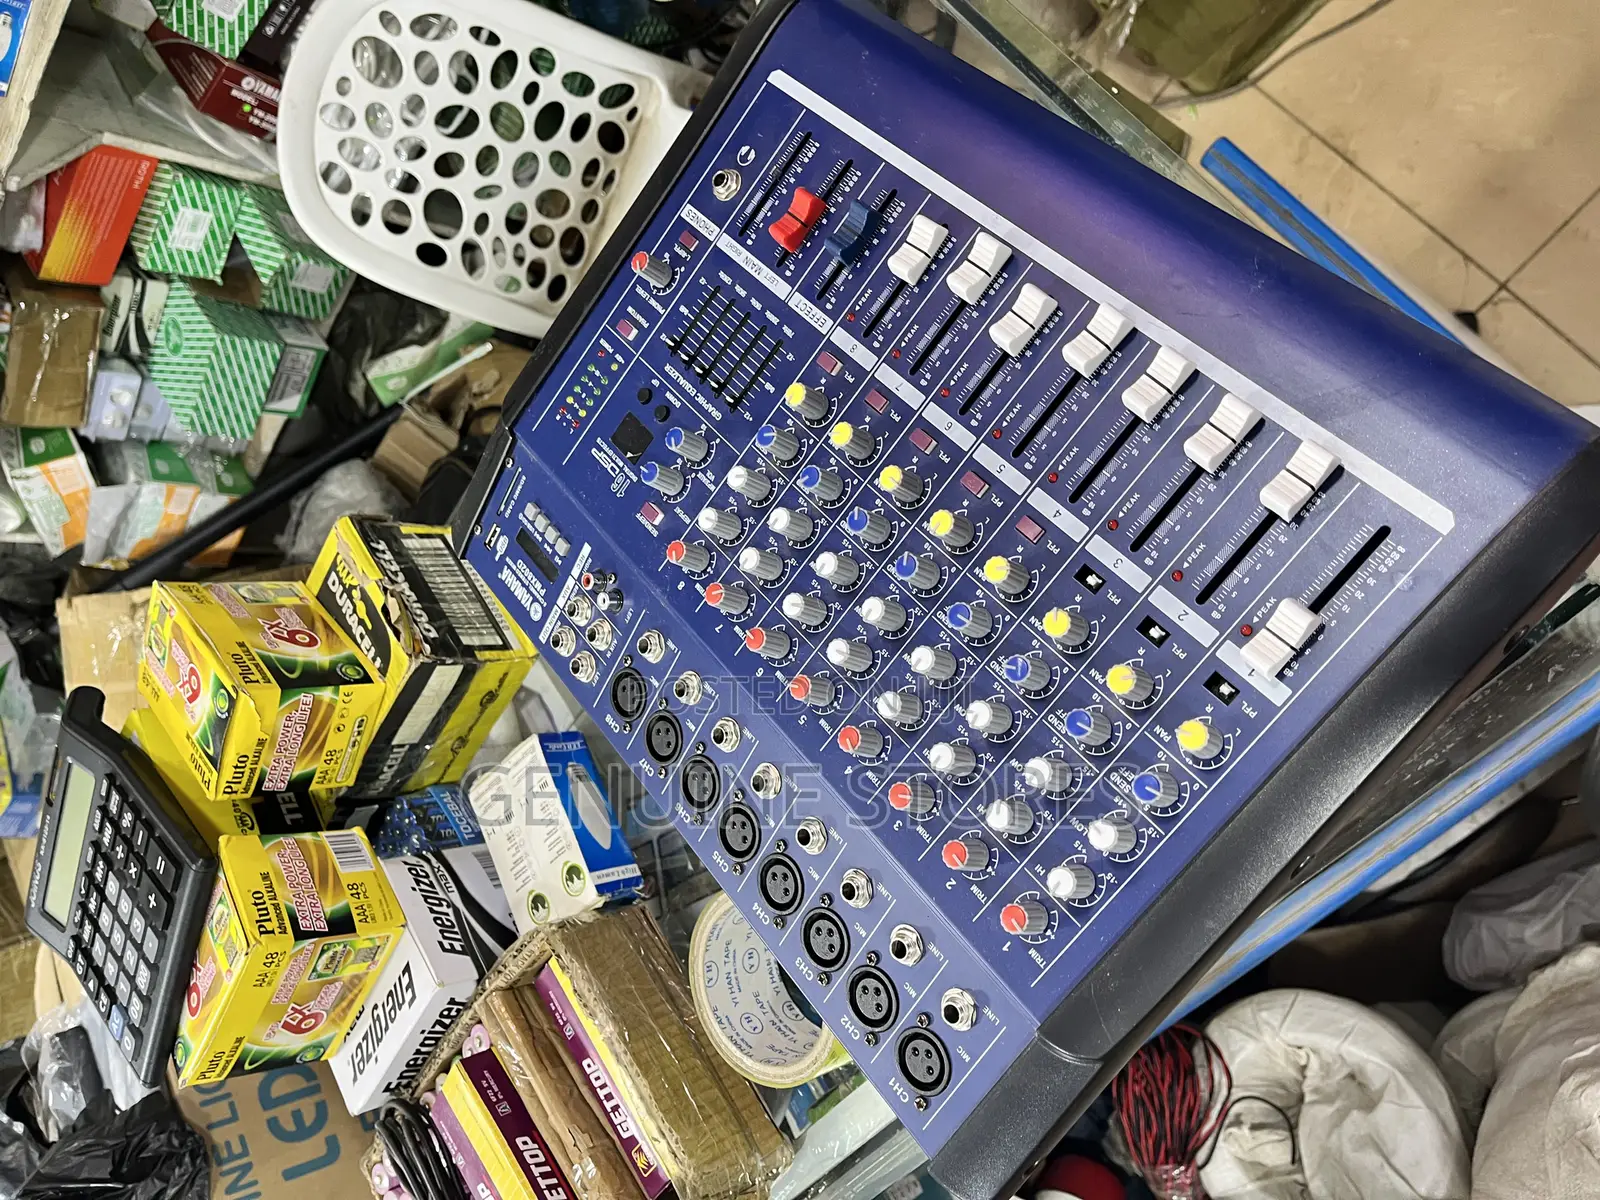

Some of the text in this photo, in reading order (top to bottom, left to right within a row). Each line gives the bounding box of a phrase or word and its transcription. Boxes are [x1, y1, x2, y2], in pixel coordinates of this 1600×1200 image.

[686, 209, 716, 237] PHONES
[743, 256, 764, 273] MAIN
[763, 272, 780, 288] LEFT
[859, 289, 873, 306] PEAK
[626, 305, 650, 329] PHANTOM
[794, 301, 827, 329] EFFECT
[904, 324, 919, 343] PEAK
[843, 370, 856, 383] PFL
[954, 362, 969, 381] PEAK
[651, 378, 660, 388] UP
[664, 363, 723, 422] GRAPHIC EQUALIZER
[665, 391, 682, 409] DOWN
[890, 409, 902, 422] PFL
[1005, 403, 1022, 422] PEAK
[938, 449, 951, 464] PFL
[1062, 446, 1079, 466] PEAK
[591, 447, 631, 498] 16 DSP
[706, 470, 716, 482] VOL
[996, 464, 1006, 474] 5
[505, 500, 515, 518] CARD
[990, 493, 1004, 508] PFL
[1121, 492, 1141, 514] PEAK
[673, 506, 691, 525] REPEAT
[1046, 539, 1061, 555] PFL
[1187, 542, 1207, 564] PEAK
[577, 554, 587, 571] REC
[1113, 558, 1123, 569] 3
[516, 558, 546, 596] PMX802D
[501, 565, 532, 612] YAMAHA
[561, 585, 572, 601] AUX
[1105, 589, 1122, 605] PFL
[624, 607, 635, 624] LEFT
[1177, 610, 1189, 621] 2
[1257, 596, 1278, 618] PEAK
[541, 609, 561, 642] MAIN OUT
[715, 624, 724, 634] 7
[609, 637, 620, 650] AUX
[665, 638, 680, 654] LINE
[1171, 642, 1188, 660] PFL
[231, 653, 261, 684] Pluto
[755, 667, 764, 678] 6
[1088, 667, 1108, 685] PAN
[1282, 669, 1295, 678] dB
[592, 672, 602, 688] LEFT
[649, 674, 661, 690] MIC
[702, 680, 719, 698] LINE
[1240, 700, 1258, 719] PFL
[604, 713, 621, 734] CH8
[684, 718, 696, 733] MIC
[798, 715, 808, 726] 5
[818, 718, 834, 736] TRIM
[1048, 714, 1067, 735] SEND
[275, 757, 295, 791] EXTRA
[288, 724, 307, 759] LONG
[299, 693, 314, 727] LIFE!
[742, 726, 758, 744] LINE
[1153, 724, 1172, 743] PAN
[264, 709, 299, 790] EXTRA POWER,
[324, 749, 337, 765] 48
[223, 754, 251, 795] Pluto
[638, 758, 655, 778] CH7
[723, 765, 736, 780] MIC
[844, 765, 853, 775] 4
[1117, 767, 1135, 782] EFF
[783, 774, 799, 792] LINE
[866, 770, 881, 787] TRIM
[1109, 771, 1132, 792] SEND
[440, 791, 475, 840] TOCEBAL
[674, 803, 691, 824] CH6
[976, 804, 987, 814] HI
[763, 813, 776, 828] MIC
[893, 820, 903, 831] 3
[1070, 817, 1089, 836] LOW
[102, 823, 112, 847] MU
[828, 826, 845, 846] LINE
[915, 825, 933, 843] TRIM
[276, 848, 302, 893] POWER,
[711, 850, 730, 873] CH5
[1034, 864, 1046, 876] HI
[434, 863, 454, 894] max
[807, 865, 821, 882] MIC
[30, 860, 43, 908] JOINUS
[347, 882, 362, 900] 48
[360, 882, 370, 899] PCS
[876, 881, 894, 902] LINE
[945, 877, 957, 890] 2
[293, 860, 329, 932] EXTRA LONG
[969, 883, 988, 904] TRIM
[251, 890, 277, 937] Pluto
[293, 891, 314, 931] EXTRA
[354, 903, 371, 924] AAA
[401, 861, 470, 956] Energizer
[751, 902, 771, 926] CH4
[853, 922, 868, 938] MIC
[67, 939, 75, 958] OFF
[723, 939, 734, 966] TAPE
[926, 941, 945, 962] LINE
[1002, 940, 1012, 952] 1
[77, 958, 86, 974] GT
[275, 950, 287, 968] PCS
[1028, 948, 1047, 969] TRIM
[252, 971, 268, 988] AAA
[263, 951, 280, 968] 48
[794, 957, 815, 981] CH3
[725, 971, 738, 990] HAN
[903, 981, 918, 999] MIC
[100, 993, 108, 1012] CE
[752, 991, 770, 1016] TAPE
[111, 1013, 121, 1035] AC
[350, 961, 417, 1084] Energizer
[981, 1005, 1002, 1027] LINE
[840, 1016, 861, 1041] CH2
[956, 1045, 971, 1063] MIC
[196, 1051, 226, 1081] Pluto
[581, 1057, 635, 1140] GETTOP
[888, 1077, 910, 1103] CH1
[258, 1066, 342, 1181] LED
[515, 1136, 568, 1200] ETTOP
